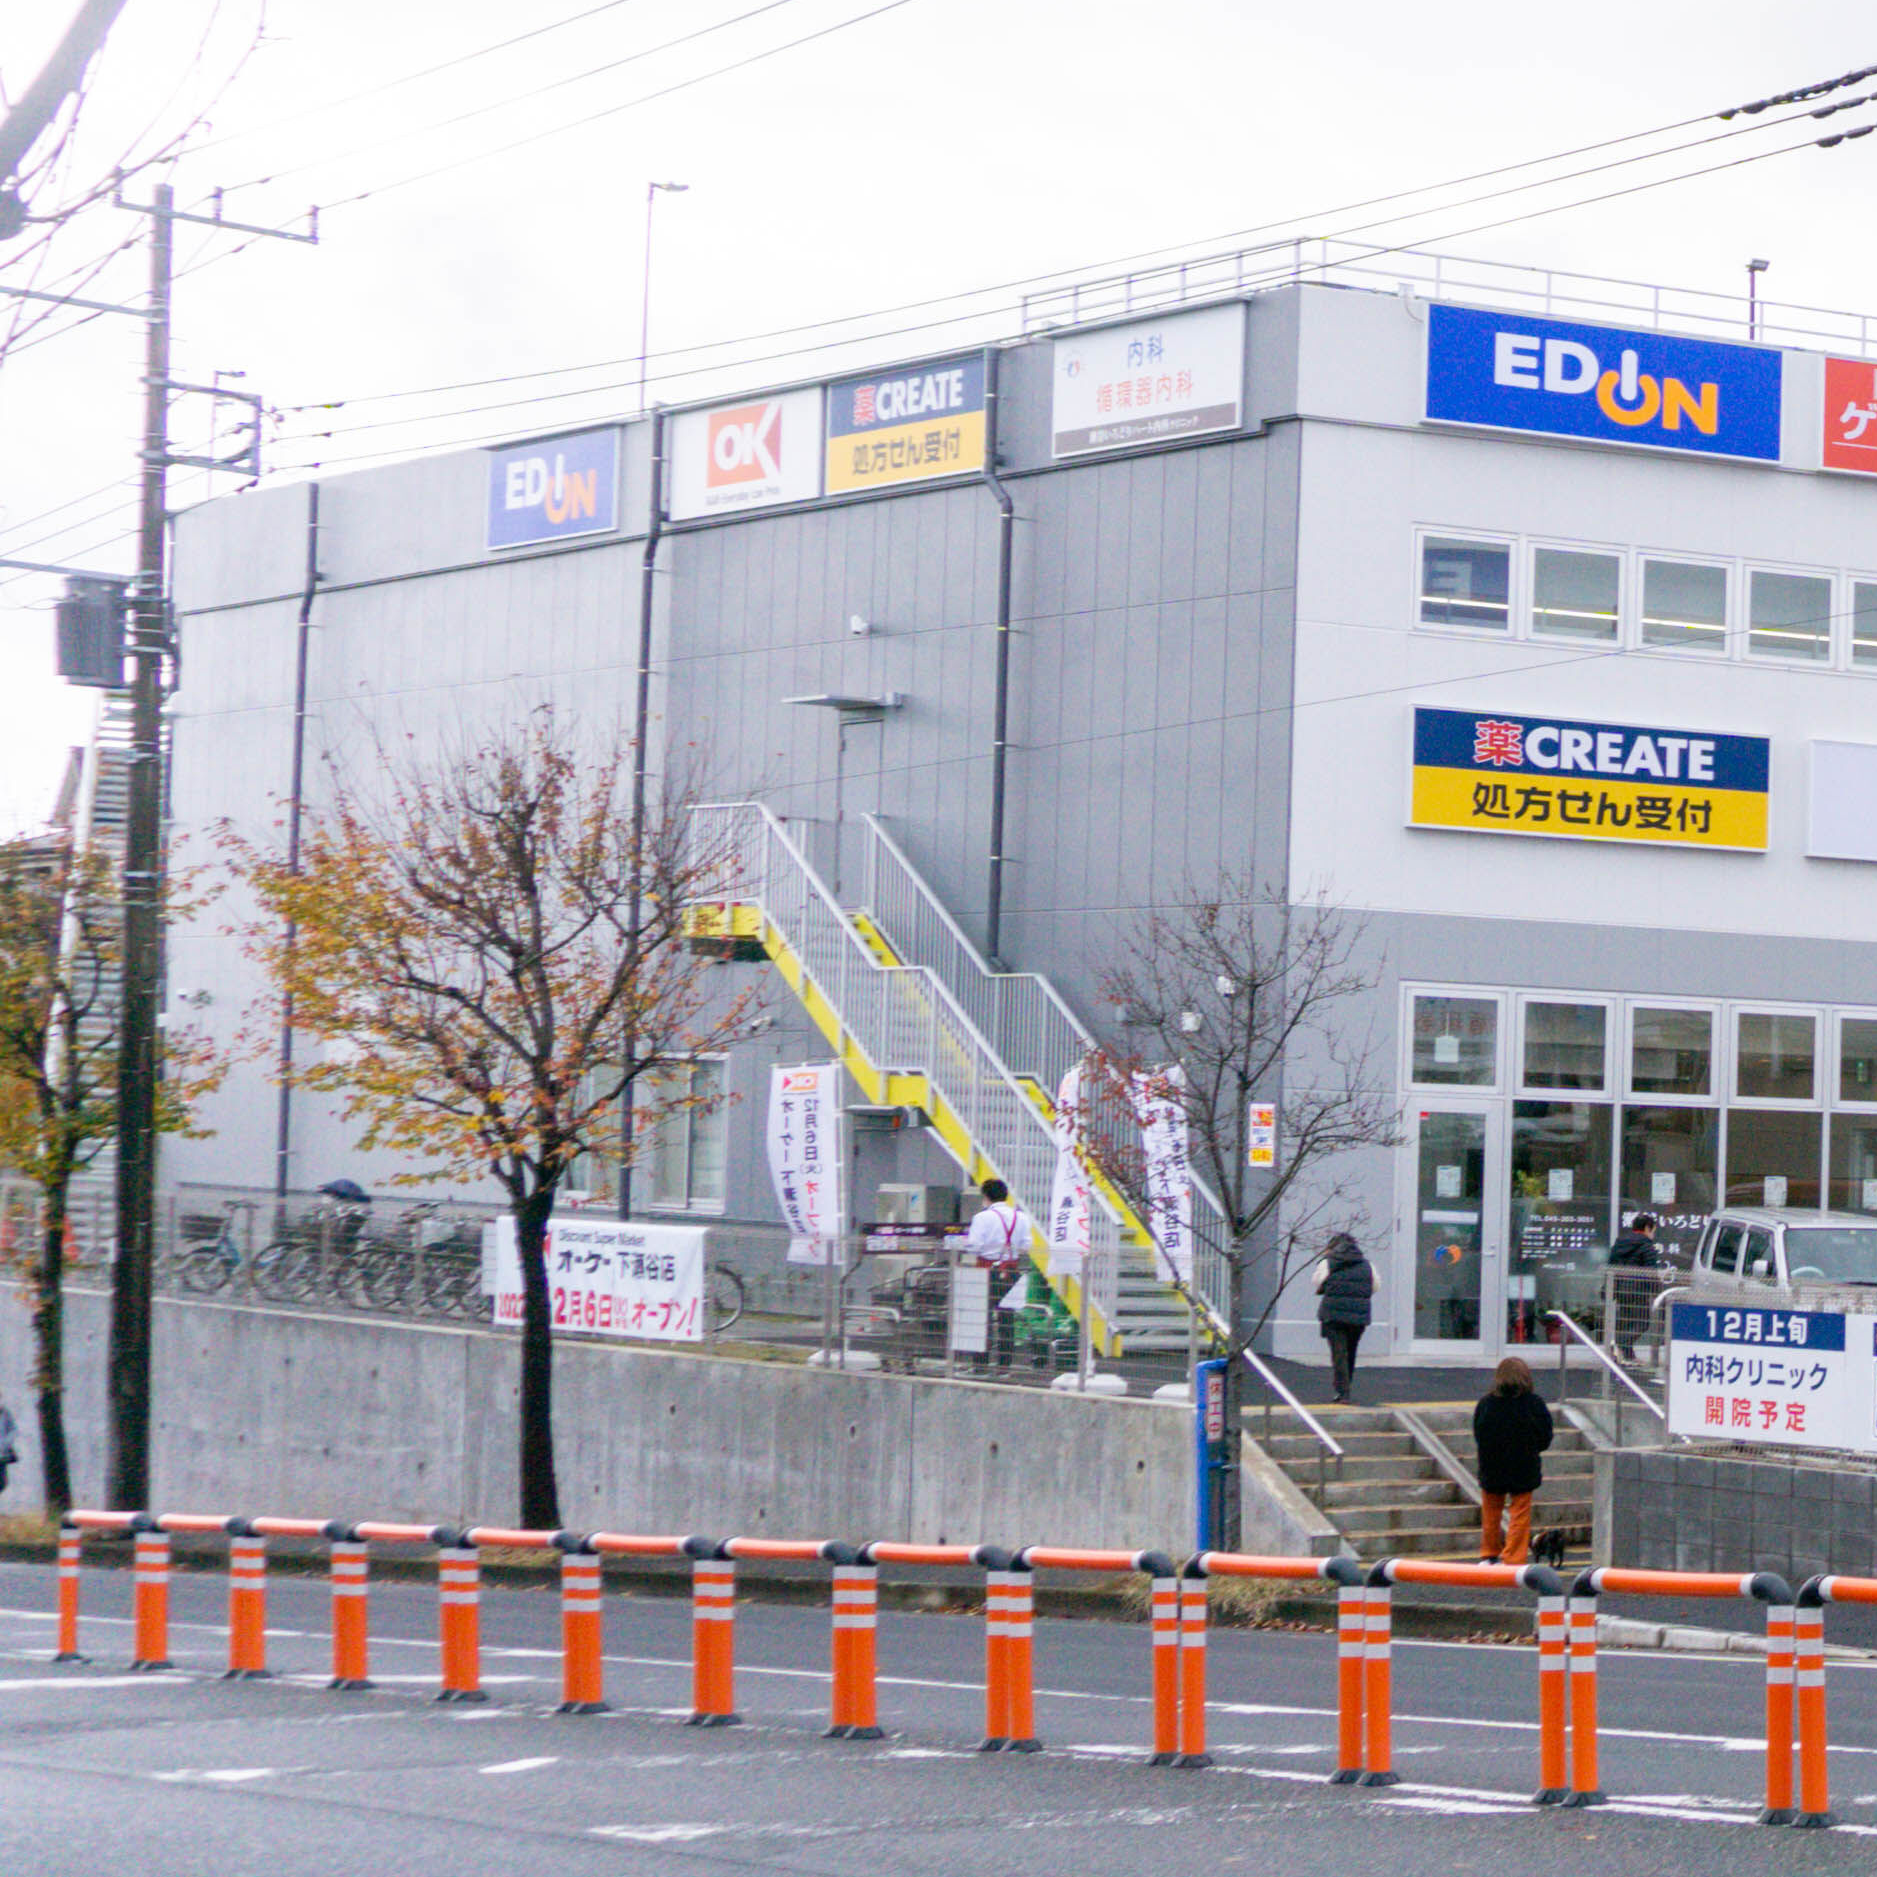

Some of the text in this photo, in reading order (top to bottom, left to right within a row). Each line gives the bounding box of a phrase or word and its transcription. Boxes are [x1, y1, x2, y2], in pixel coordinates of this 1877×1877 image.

[1127, 334, 1164, 368] 内科
[1494, 331, 1719, 435] EDION
[712, 403, 781, 478] OK
[852, 427, 961, 475] 処方せん受付
[505, 454, 597, 524] EDION
[1471, 781, 1712, 834] 処方せん受付
[1706, 1309, 1808, 1345] 12月上旬
[1685, 1353, 1829, 1392] 内科クリニック
[1705, 1395, 1807, 1433] 開院予定
